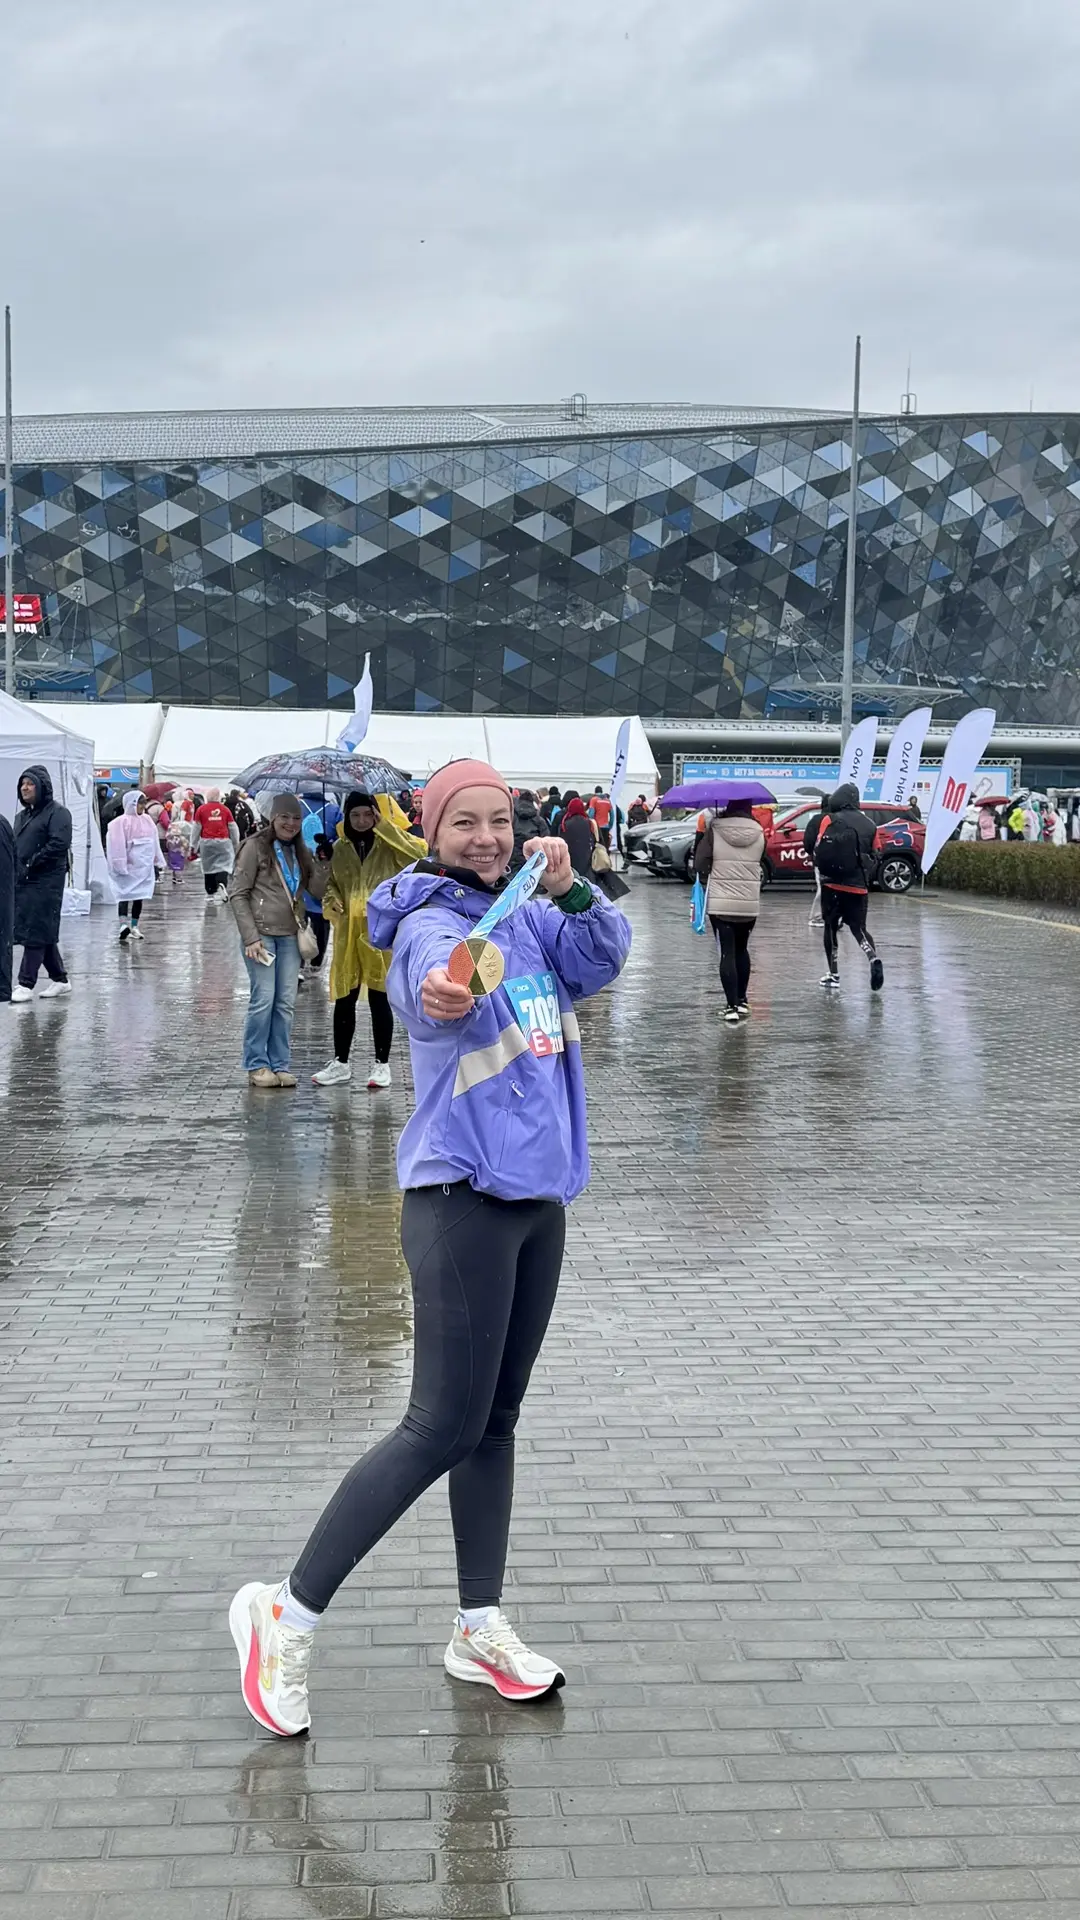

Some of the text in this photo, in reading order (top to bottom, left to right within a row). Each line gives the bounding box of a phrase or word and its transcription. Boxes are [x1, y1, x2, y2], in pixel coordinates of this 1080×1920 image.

[850, 748, 863, 778] М90
[899, 741, 913, 774] М70
[518, 995, 560, 1034] 702
